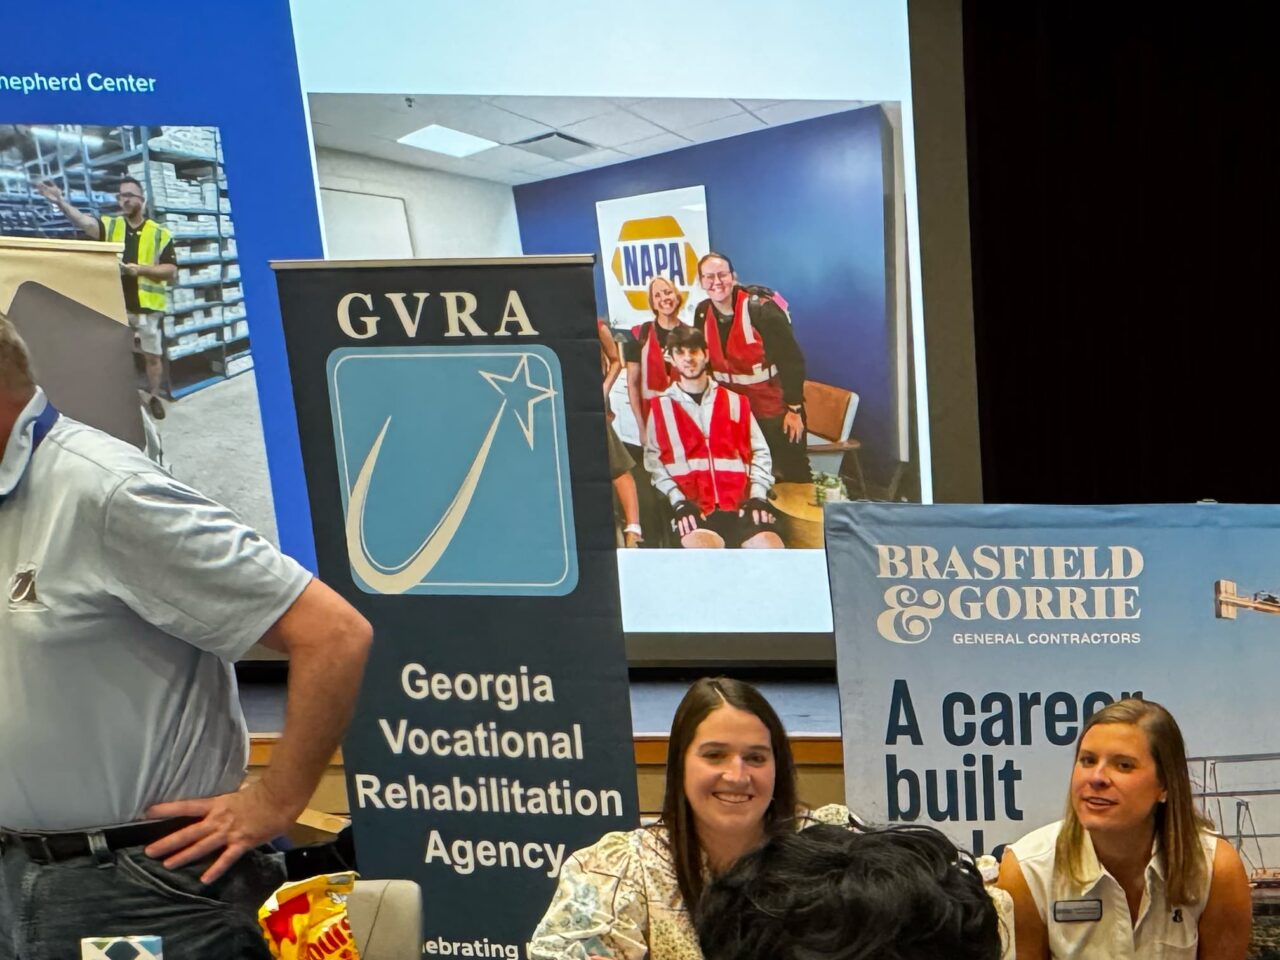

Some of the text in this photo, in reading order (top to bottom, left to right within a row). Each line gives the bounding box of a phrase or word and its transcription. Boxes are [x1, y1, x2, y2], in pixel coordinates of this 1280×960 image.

[87, 72, 157, 93] Center
[623, 241, 685, 287] NAPA
[336, 290, 540, 340] GVRA
[874, 544, 1144, 580] BRASFIELD
[953, 633, 1141, 645] GENERAL CONTRACTORS
[401, 662, 555, 711] Georgia
[885, 679, 923, 746] A
[378, 718, 584, 760] Vocational
[355, 773, 624, 817] Rehabilitation
[885, 754, 1023, 822] built
[424, 830, 566, 878] Agency
